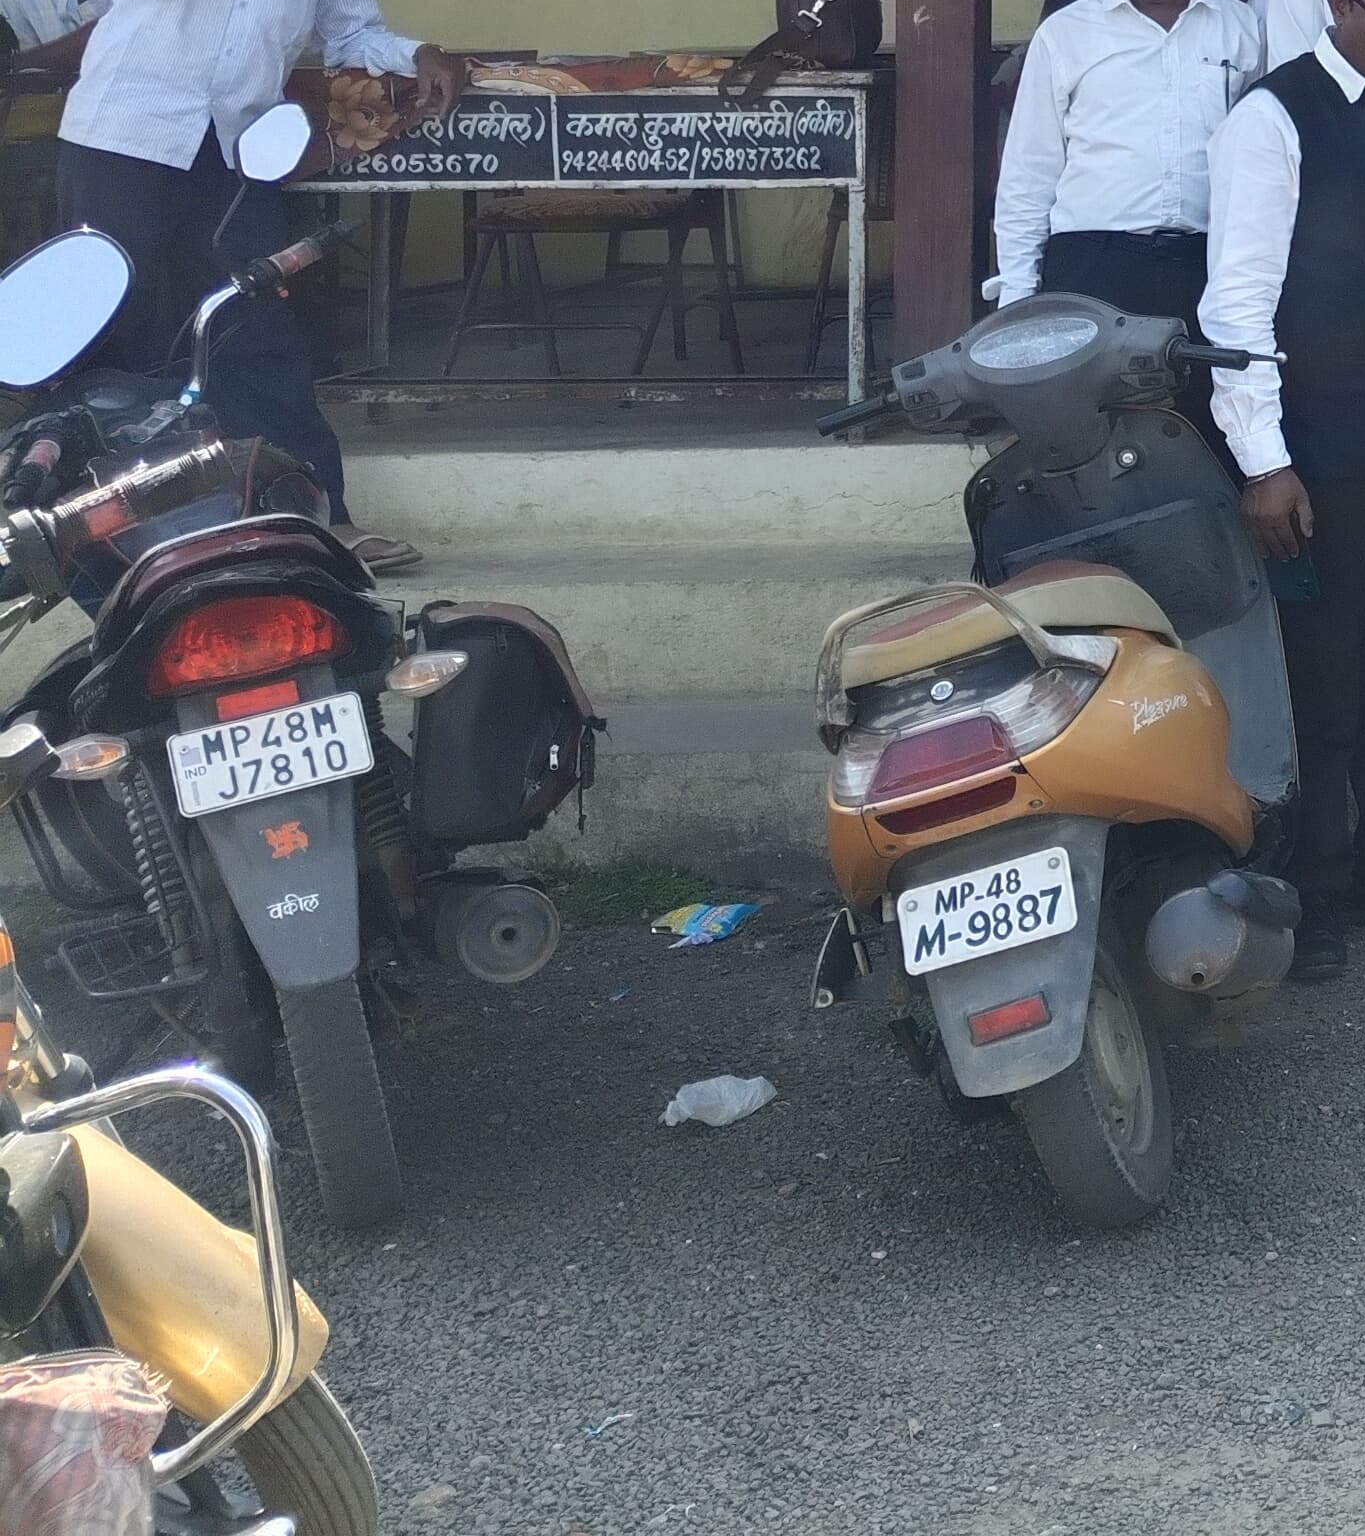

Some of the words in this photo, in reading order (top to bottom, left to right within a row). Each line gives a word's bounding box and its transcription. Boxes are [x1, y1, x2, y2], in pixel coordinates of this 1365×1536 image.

[448, 100, 545, 148] (वकील)
[565, 112, 641, 146] कमल
[642, 112, 711, 150] कुमार
[712, 100, 795, 145] सोलंकी
[794, 99, 854, 144] (वकील)
[1130, 693, 1188, 735] Pleasure
[184, 766, 208, 780] IND
[266, 893, 320, 919] वकील
[935, 868, 1021, 915] MP-48
[914, 884, 1062, 963] M-9887
